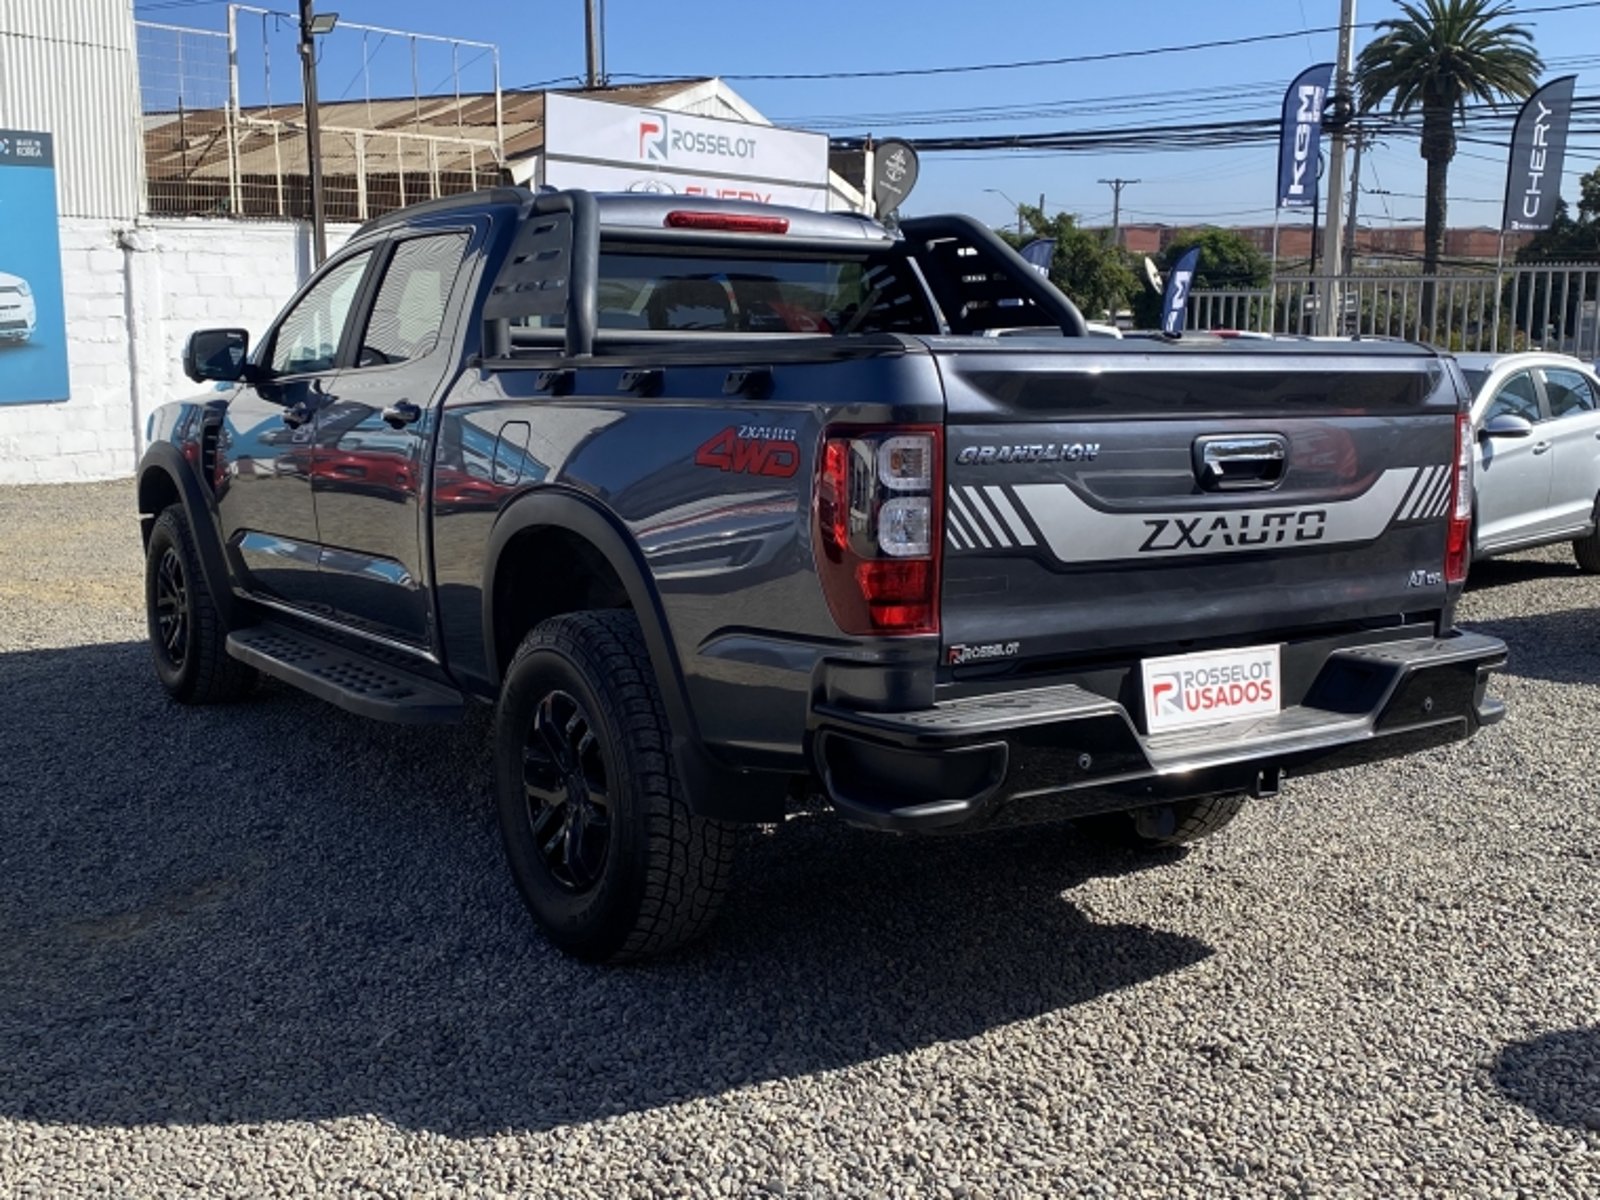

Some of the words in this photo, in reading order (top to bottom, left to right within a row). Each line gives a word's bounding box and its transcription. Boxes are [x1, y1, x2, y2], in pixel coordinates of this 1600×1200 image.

[671, 129, 757, 159] ROSSELOT
[1288, 85, 1315, 195] KGM
[1523, 101, 1552, 218] CHERY
[738, 425, 797, 441] ZXAUTO
[694, 426, 801, 478] 4WD
[1138, 509, 1327, 552] ZXAUTO
[964, 641, 1020, 659] ROSSELOT
[1183, 661, 1272, 689] ROSSELOT
[1185, 680, 1273, 712] USADOS
